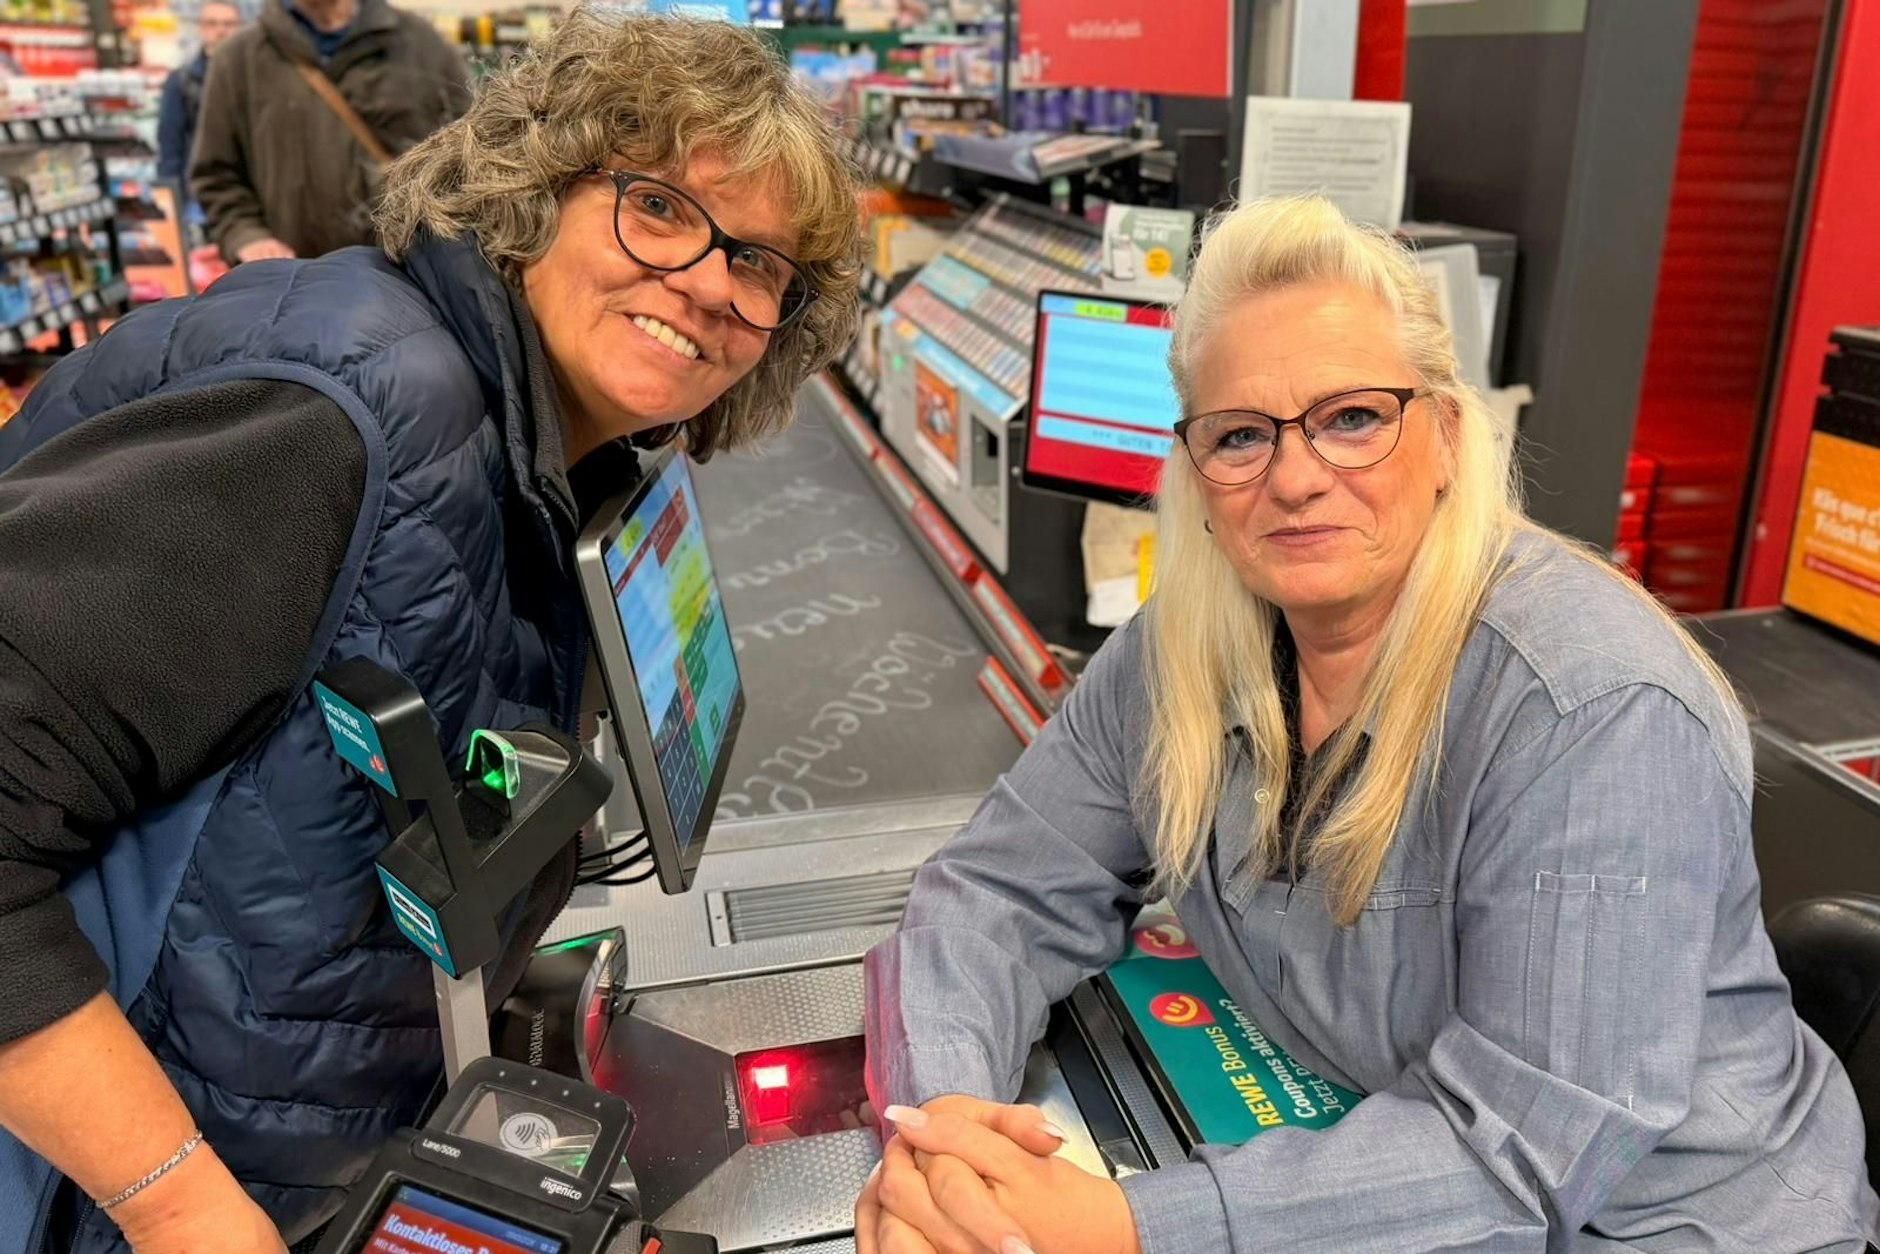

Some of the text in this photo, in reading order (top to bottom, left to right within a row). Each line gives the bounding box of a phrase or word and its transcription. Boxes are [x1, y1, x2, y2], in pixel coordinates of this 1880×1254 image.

[1219, 998, 1275, 1058] aktiviert?
[1205, 1026, 1284, 1126] REWE Bonus
[1266, 1058, 1318, 1118] Coupons
[1307, 1079, 1345, 1115] Jetzt
[540, 1177, 583, 1200] ingenico
[384, 1214, 474, 1254] Kontaktloses
